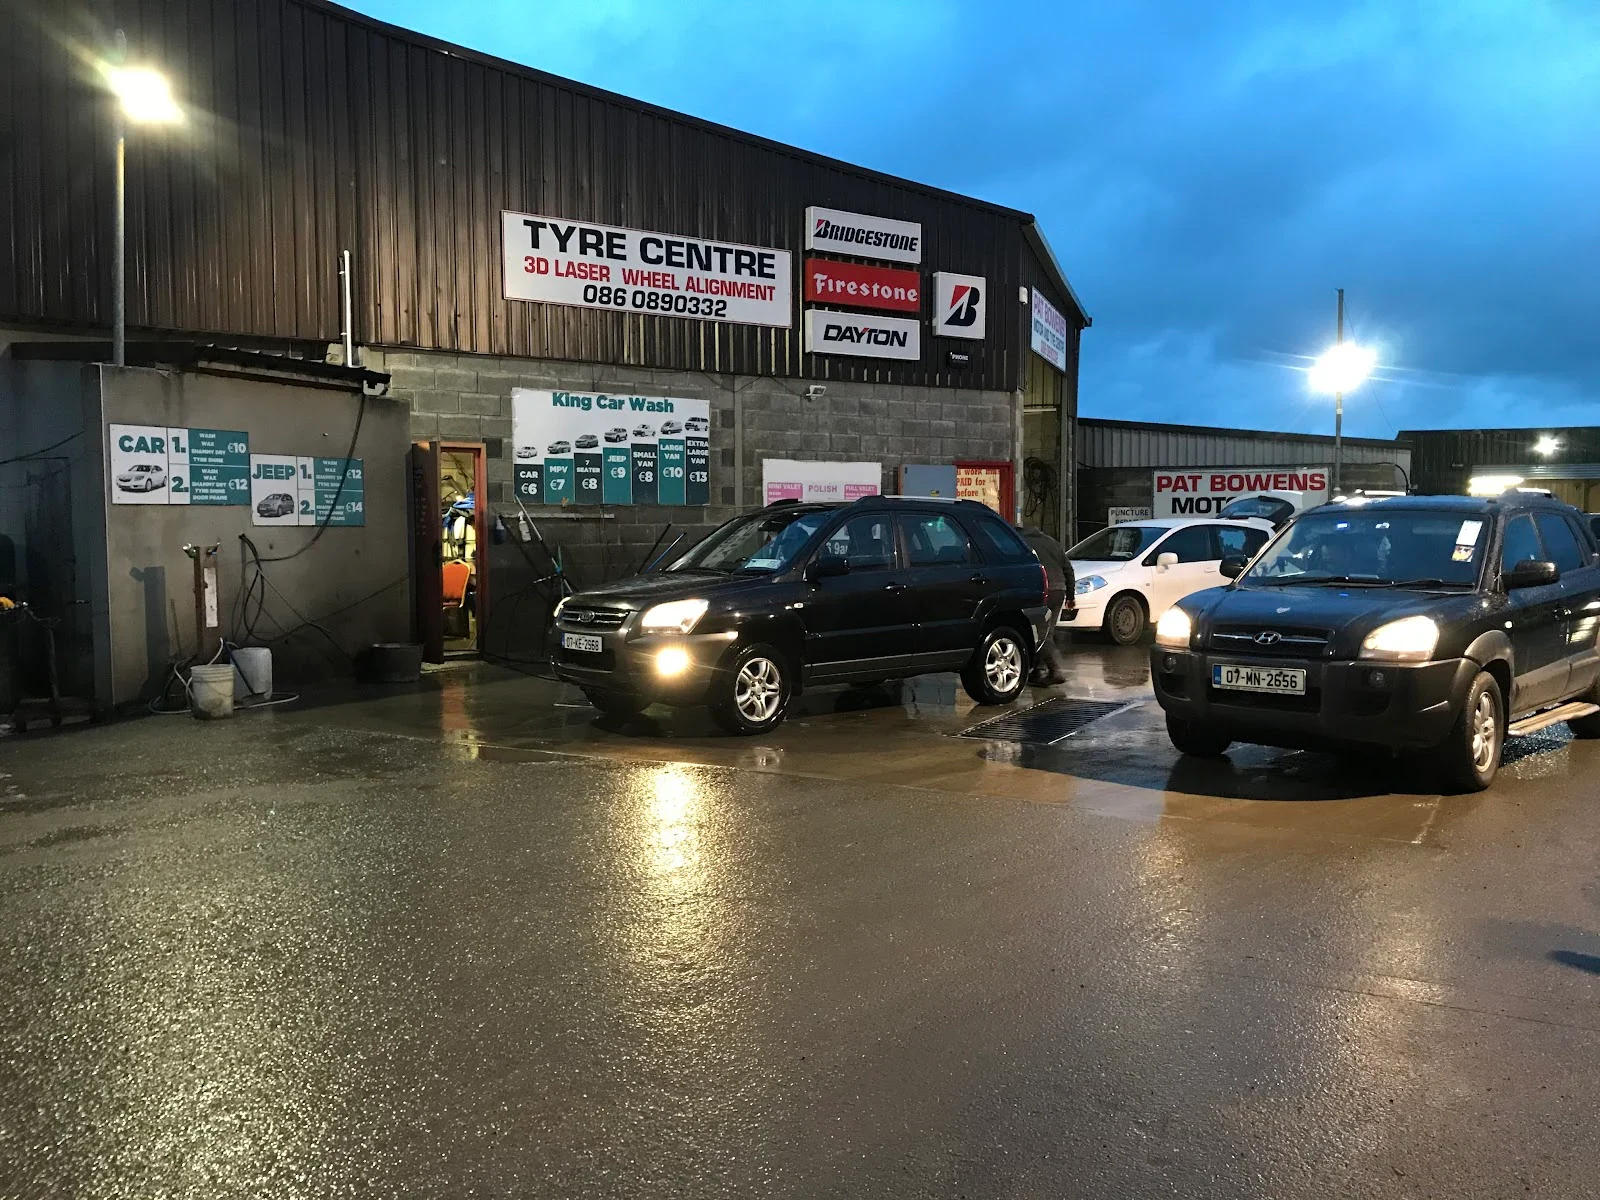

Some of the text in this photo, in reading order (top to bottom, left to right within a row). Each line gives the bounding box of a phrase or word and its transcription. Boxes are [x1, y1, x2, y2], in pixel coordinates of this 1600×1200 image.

[814, 218, 918, 252] BRIDGESTONE
[523, 220, 776, 279] TYRE CENTRE
[524, 256, 776, 301] 3D LASER WHEEL ALIGNMENT
[813, 272, 918, 302] Firestone
[583, 284, 726, 318] 086 0890332
[824, 324, 908, 348] DAYTON
[552, 392, 674, 413] King Car Wash
[118, 435, 166, 454] CAR
[172, 436, 186, 453] 1.
[228, 442, 247, 454] €10
[252, 464, 296, 480] JEEP
[300, 464, 312, 479] 1.
[347, 469, 362, 479] €12
[611, 467, 626, 479] €9
[639, 471, 653, 482] €8
[663, 467, 683, 478] €10
[689, 471, 708, 482] €13
[172, 476, 189, 492] 2.
[228, 478, 248, 490] €12
[521, 483, 538, 495] €6
[550, 479, 565, 490] €7
[582, 478, 598, 490] €8
[1156, 473, 1326, 493] PAT BOWENS
[300, 500, 315, 515] 2.
[346, 502, 363, 512] €14
[1172, 497, 1234, 514] MOT
[1226, 669, 1297, 688] 07-MN-2656
